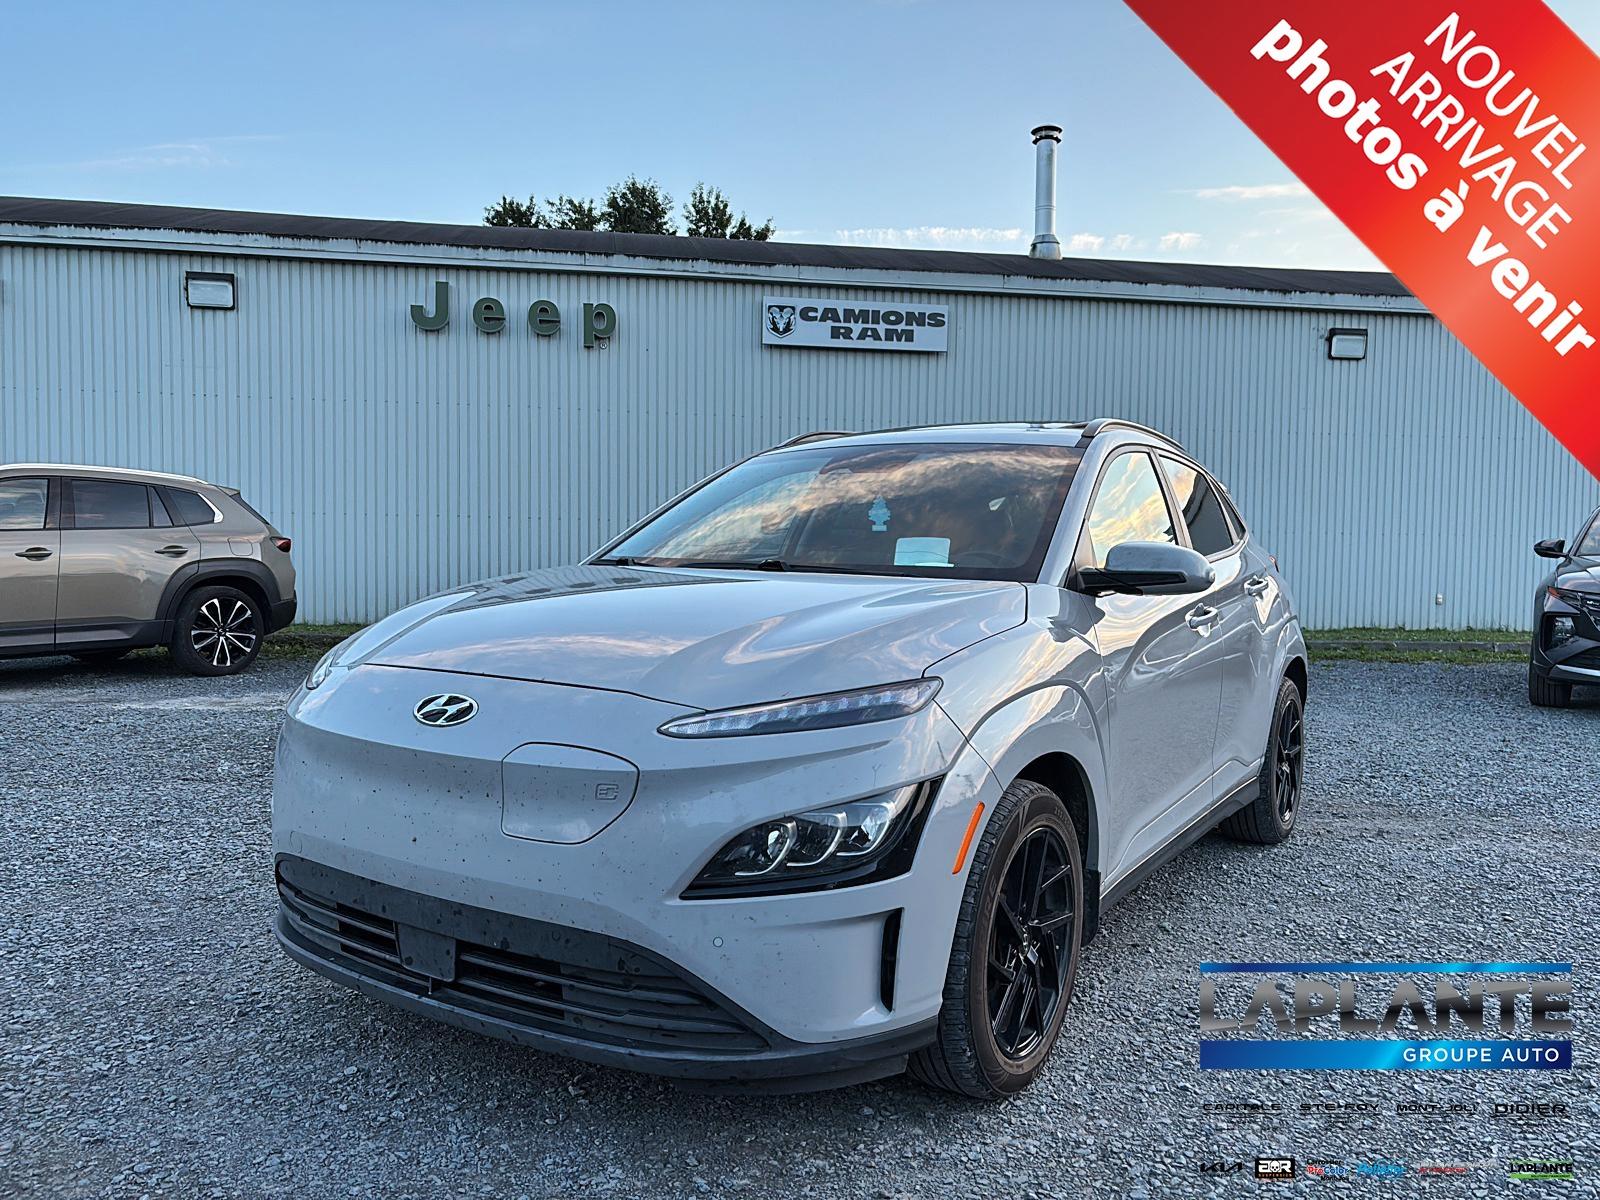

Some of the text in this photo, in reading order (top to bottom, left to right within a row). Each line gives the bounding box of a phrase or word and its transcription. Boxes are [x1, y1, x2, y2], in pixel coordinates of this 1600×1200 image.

[410, 281, 617, 348] Jeep
[799, 306, 946, 327] CAMIONS
[830, 325, 915, 342] RAM
